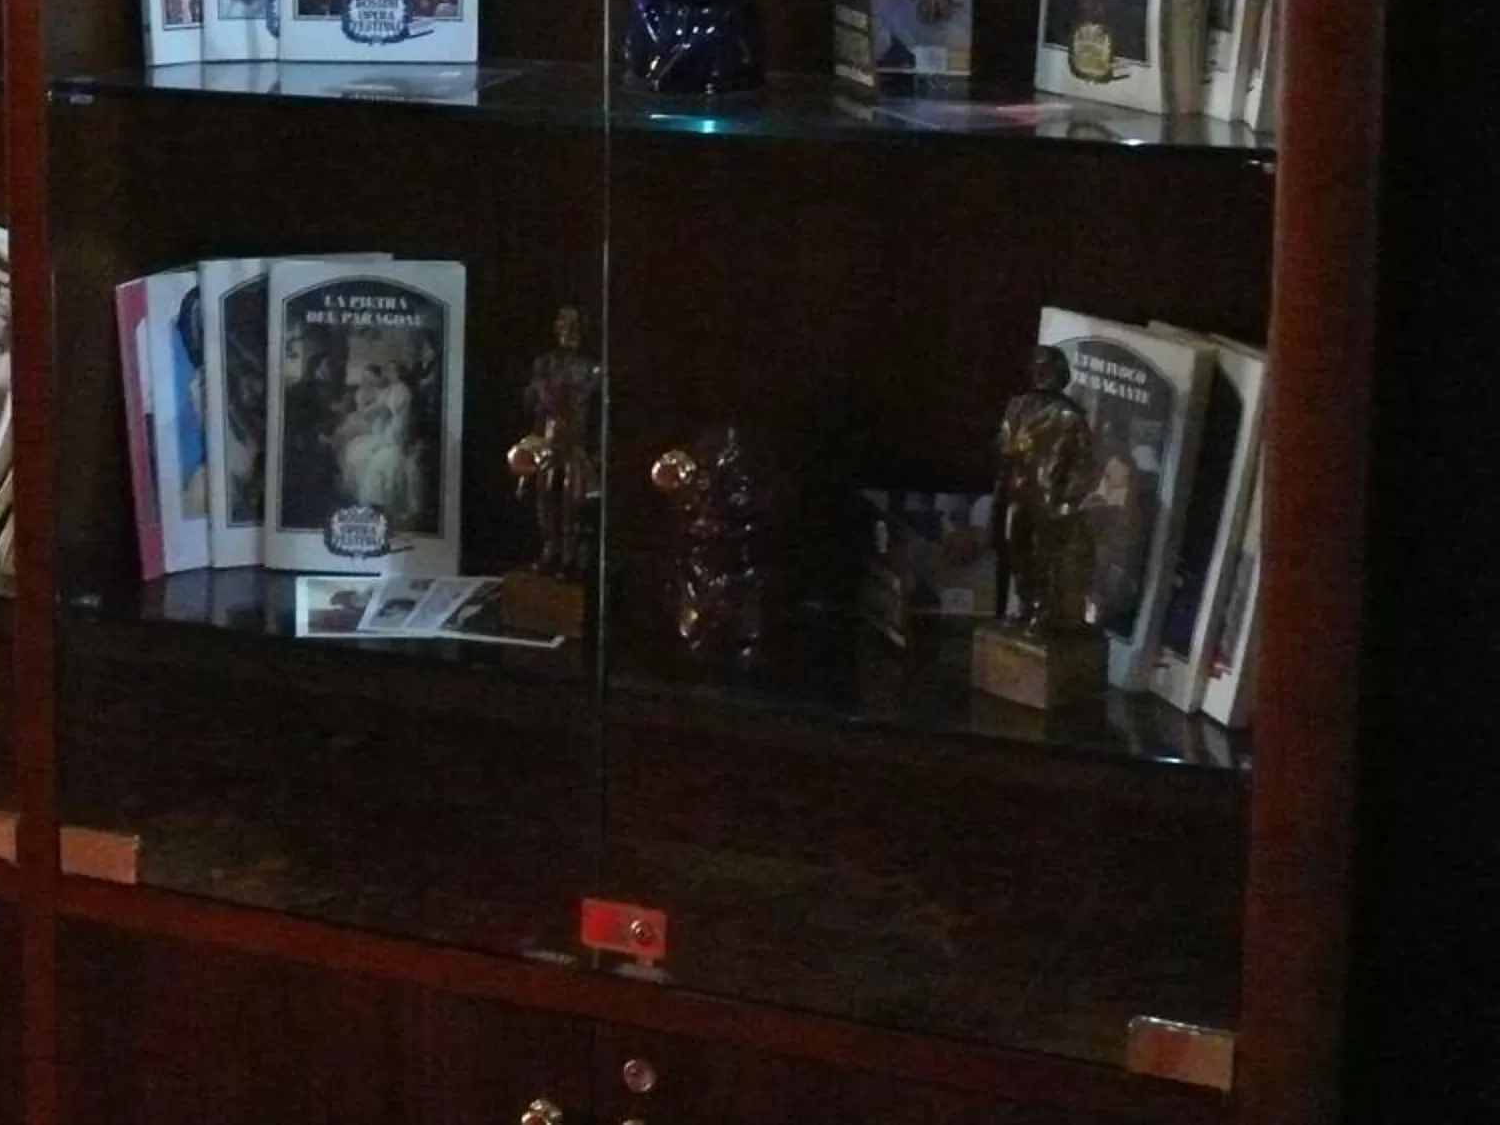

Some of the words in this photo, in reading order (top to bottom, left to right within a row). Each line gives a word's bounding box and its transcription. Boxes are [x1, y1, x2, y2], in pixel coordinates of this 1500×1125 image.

[323, 294, 346, 308] LA
[349, 295, 408, 310] PIETRA
[306, 310, 337, 324] DEL
